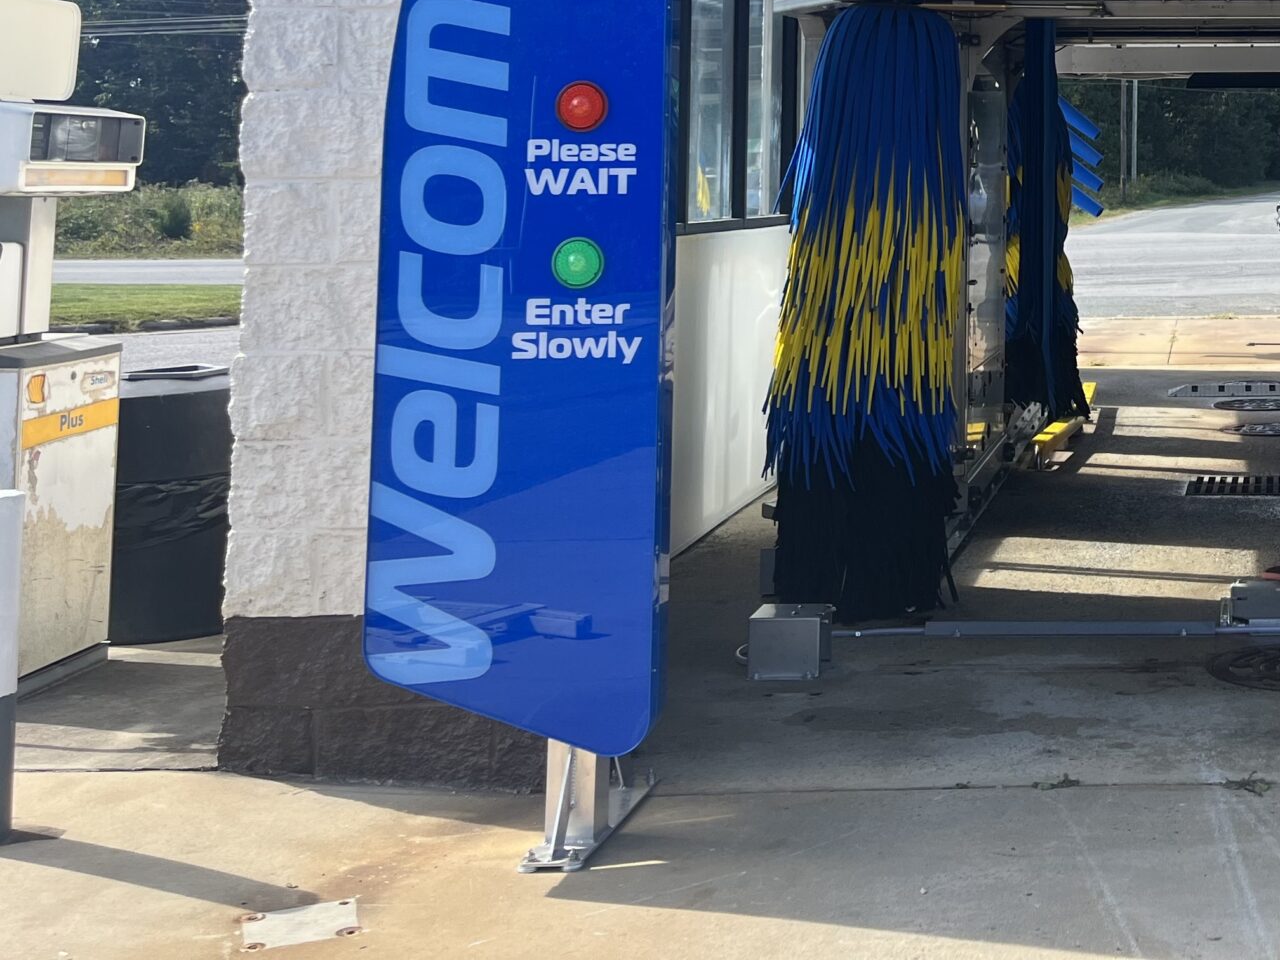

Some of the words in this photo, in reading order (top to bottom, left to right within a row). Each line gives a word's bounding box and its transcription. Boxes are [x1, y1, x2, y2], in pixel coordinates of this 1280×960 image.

[526, 139, 637, 162] Please
[524, 167, 637, 196] WAIT
[525, 298, 631, 326] Enter
[511, 330, 643, 365] Slowly
[59, 413, 85, 432] Plus
